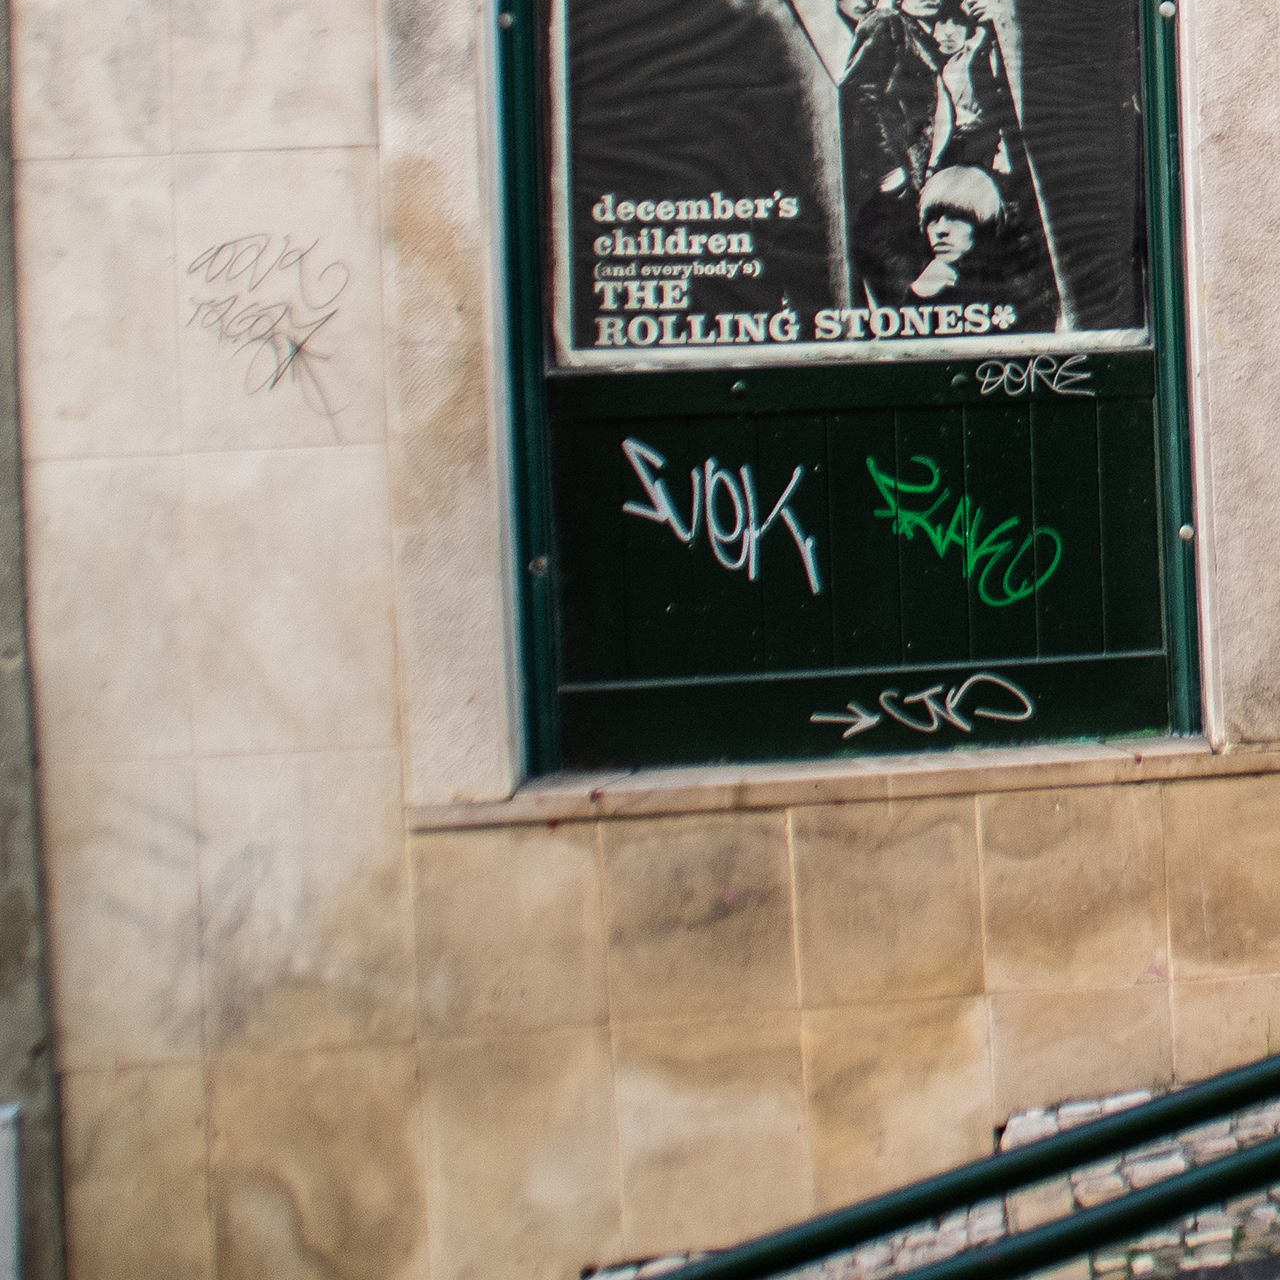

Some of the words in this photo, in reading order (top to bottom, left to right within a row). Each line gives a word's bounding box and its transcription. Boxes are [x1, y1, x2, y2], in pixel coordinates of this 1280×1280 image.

[592, 227, 754, 255] children
[594, 262, 637, 279] (and
[594, 279, 690, 310] THE
[594, 309, 800, 346] ROLLING
